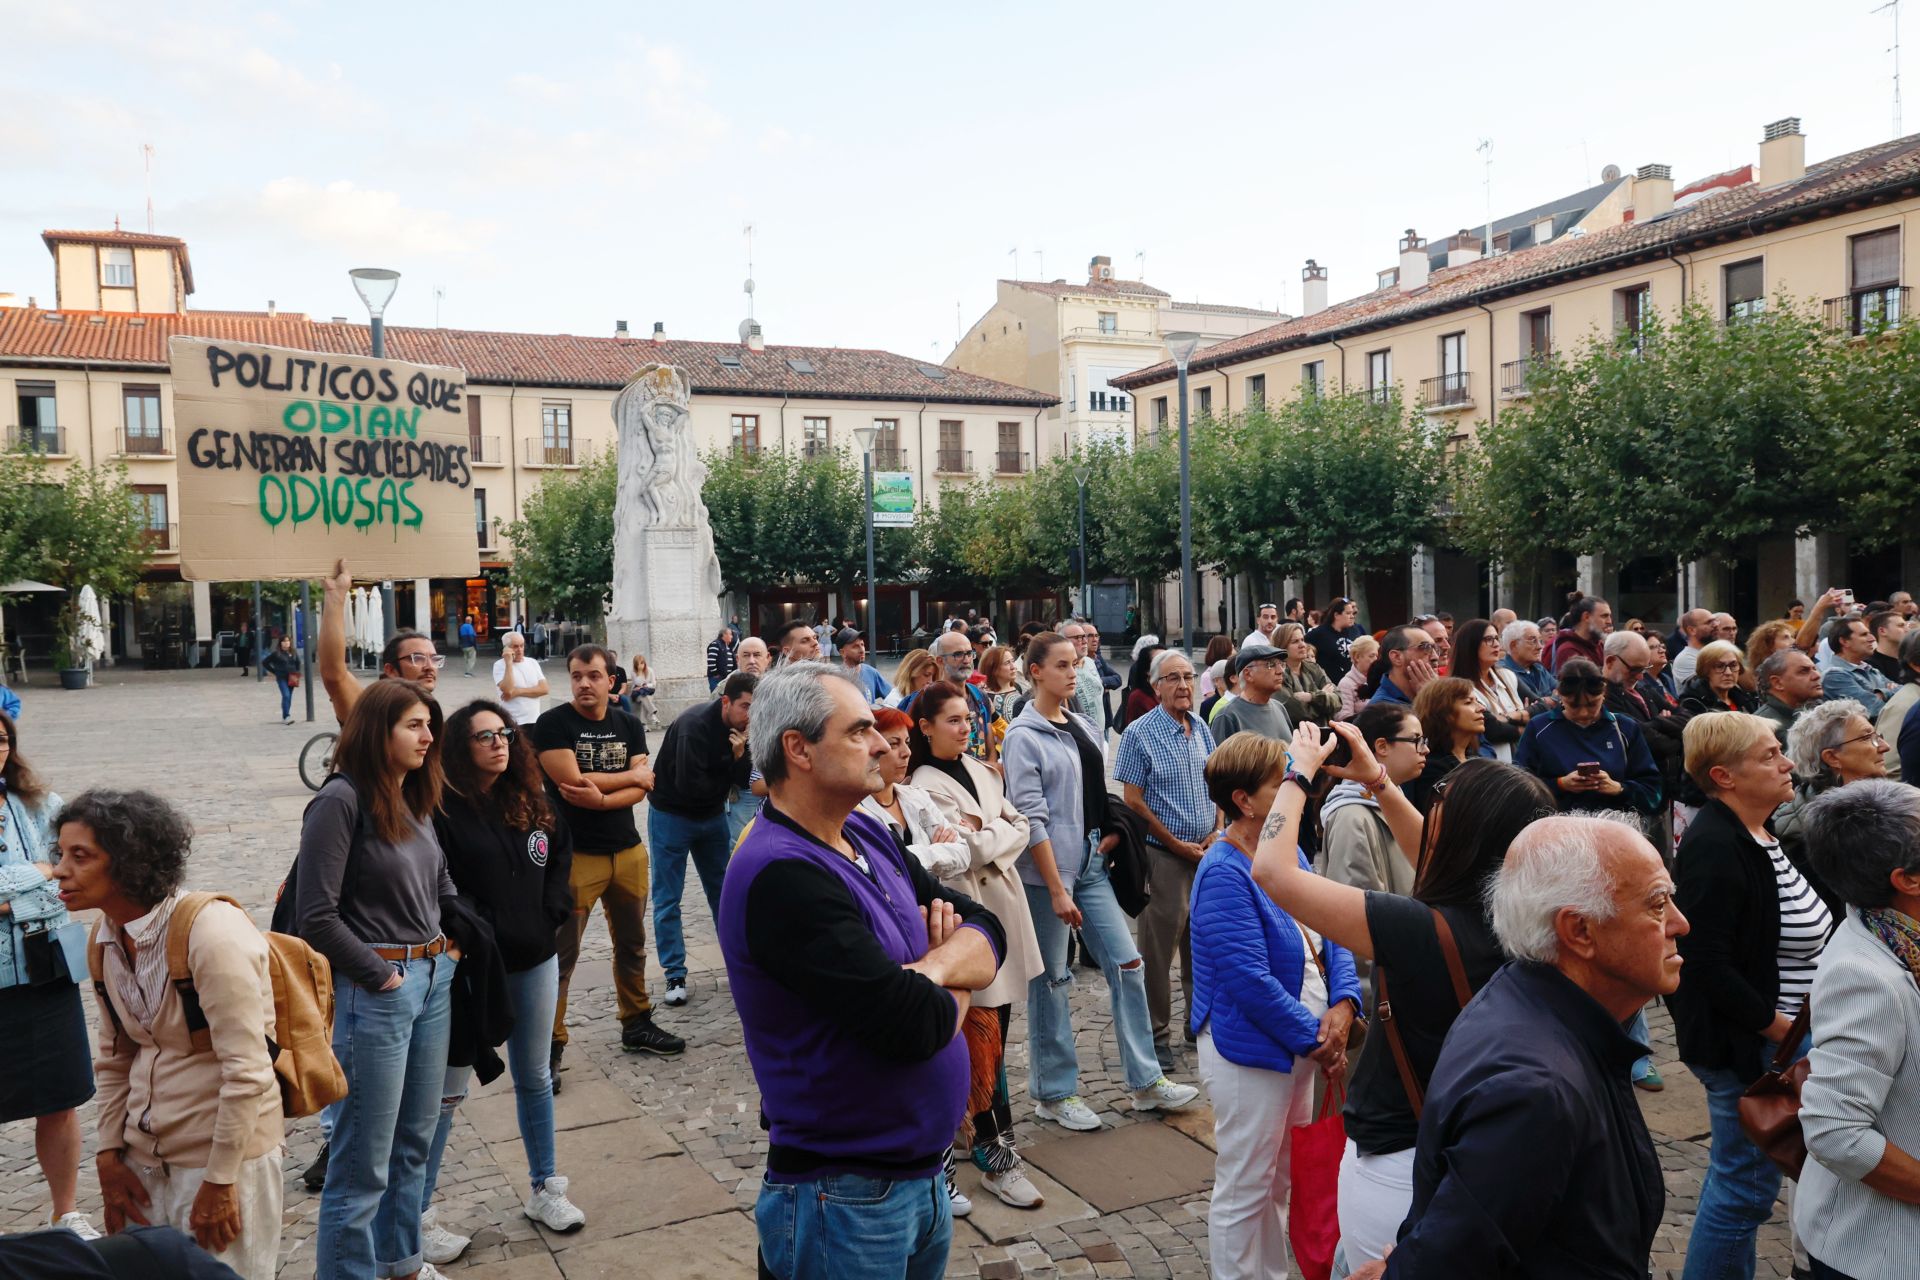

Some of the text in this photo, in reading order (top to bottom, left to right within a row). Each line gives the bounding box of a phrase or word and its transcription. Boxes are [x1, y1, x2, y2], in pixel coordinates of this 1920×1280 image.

[206, 345, 466, 414] POLITICOS QUE
[282, 400, 422, 440] ODIAN
[188, 428, 471, 488] GENERAN SOCIEDADES
[259, 474, 424, 528] ODIOSAS
